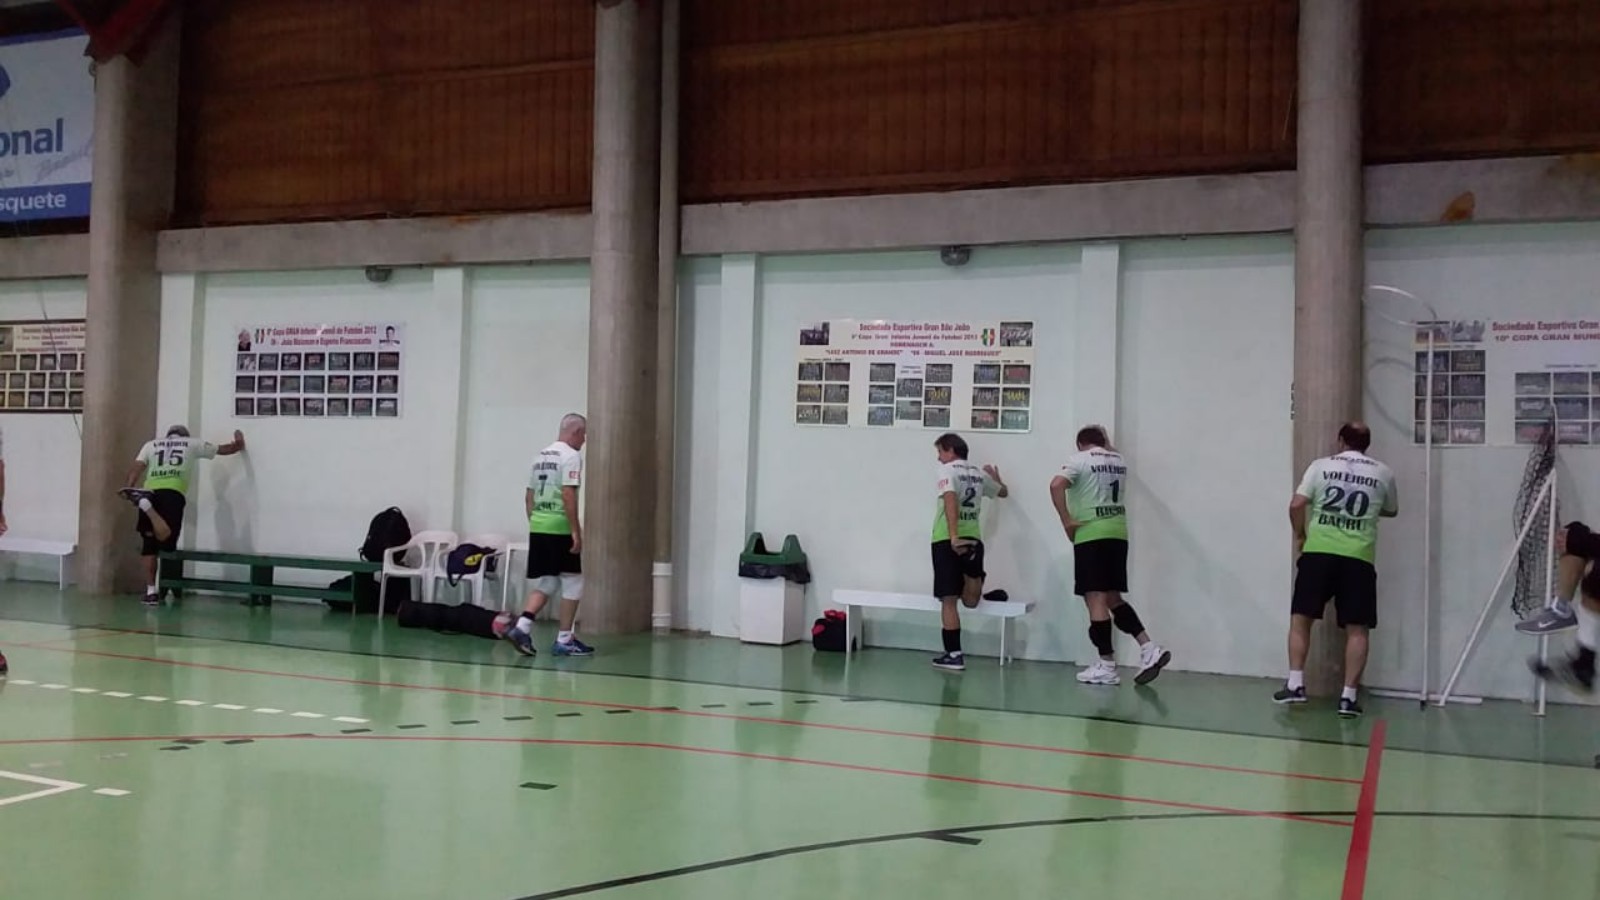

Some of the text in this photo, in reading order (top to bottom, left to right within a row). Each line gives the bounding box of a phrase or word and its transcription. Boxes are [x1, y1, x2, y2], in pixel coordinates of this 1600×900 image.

[1541, 333, 1571, 341] GRAN
[155, 449, 184, 467] 15
[962, 487, 977, 508] 2
[1110, 480, 1120, 504] 1
[1321, 486, 1370, 518] 20
[1317, 514, 1367, 531] BAURU
